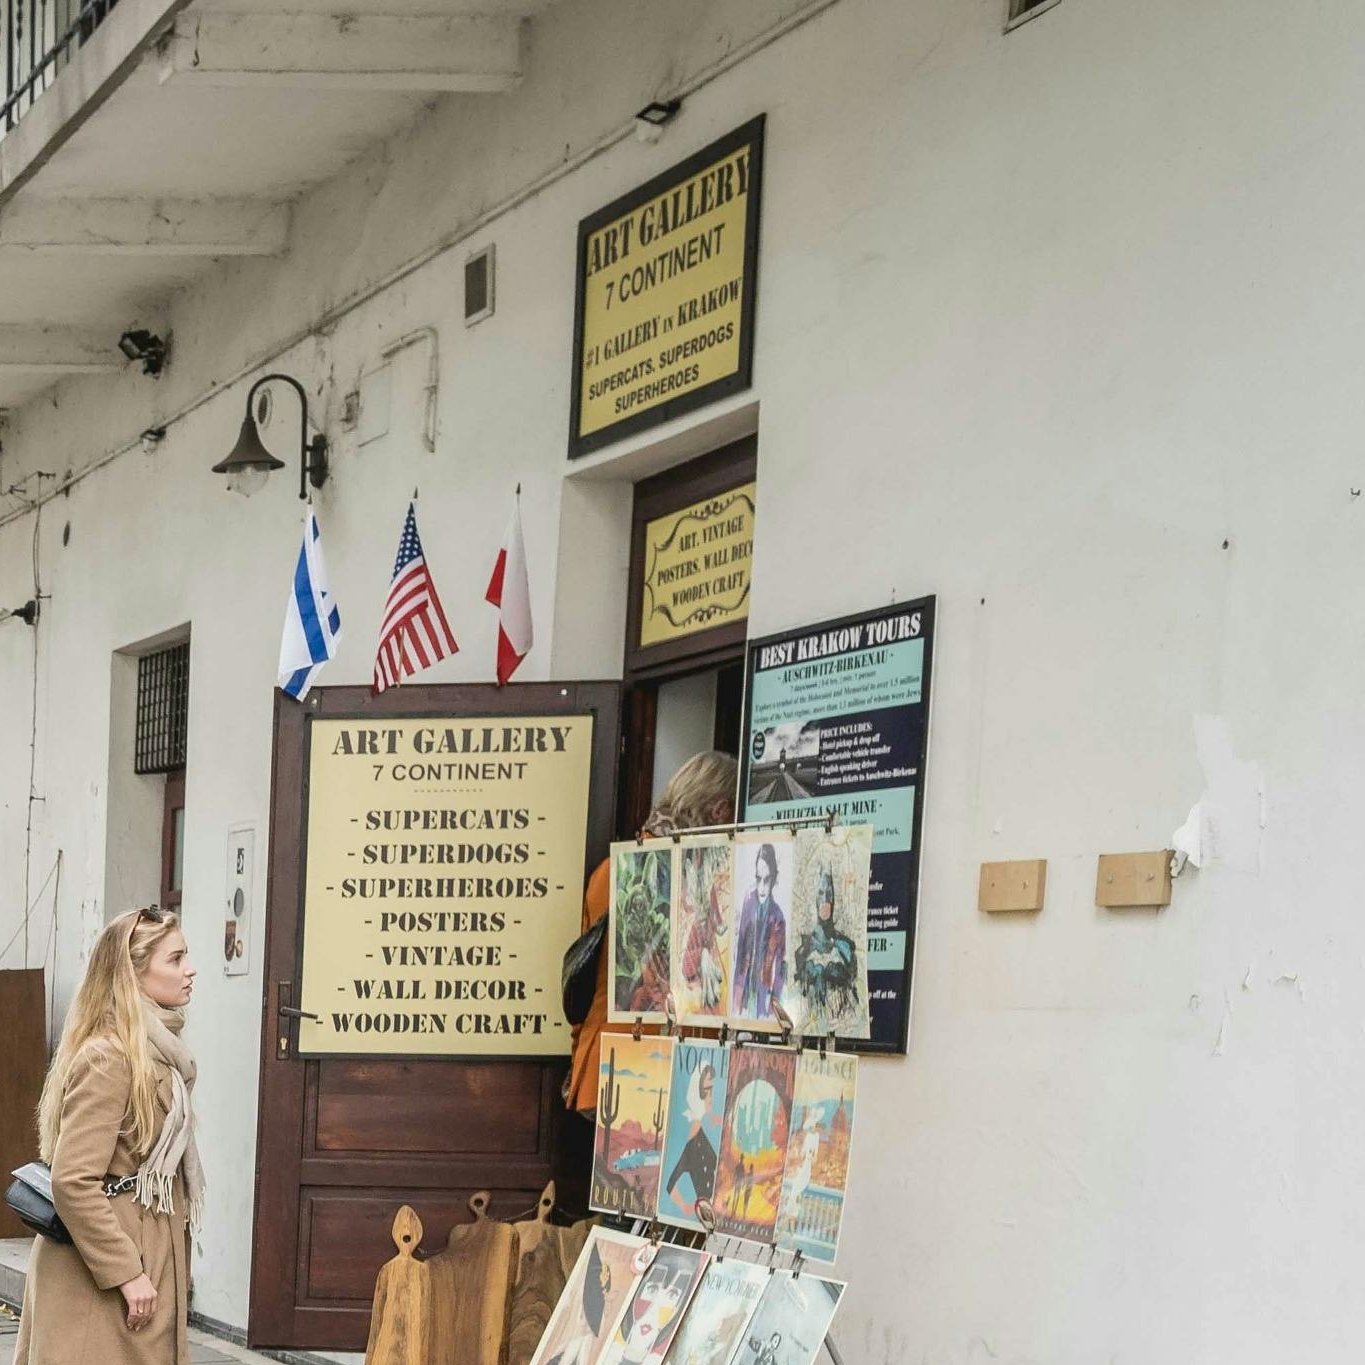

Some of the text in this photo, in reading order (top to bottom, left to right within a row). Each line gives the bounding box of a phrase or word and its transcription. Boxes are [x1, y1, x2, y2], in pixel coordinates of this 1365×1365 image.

[588, 153, 750, 277] ART GALLERY
[606, 223, 725, 310] 7 CONTINENT
[604, 315, 660, 361] GALLERY
[678, 276, 742, 327] KRAKOW
[659, 322, 734, 369] SUPERDOGS
[615, 364, 699, 414] SUPERHEROES
[702, 515, 744, 543] VINTAGE
[704, 546, 729, 570] WALL
[672, 570, 745, 606] WOODEN CRAFT
[760, 613, 921, 669] BEST KRAKOW TOURS
[782, 650, 888, 683] AUSCHWITZ-BIRKENAU
[332, 726, 572, 755] ART GALLERY
[372, 762, 528, 781] 7 CONTINENT
[365, 809, 529, 830] SUPERCATS
[852, 799, 877, 815] MINE
[362, 843, 529, 864] SUPERDOGS
[341, 877, 548, 898] SUPERHEROES
[380, 912, 505, 932] POSTERS
[381, 946, 501, 966] VINTAGE
[353, 979, 527, 1000] WALL DECOR
[332, 1013, 547, 1034] WOODEN CRAFT
